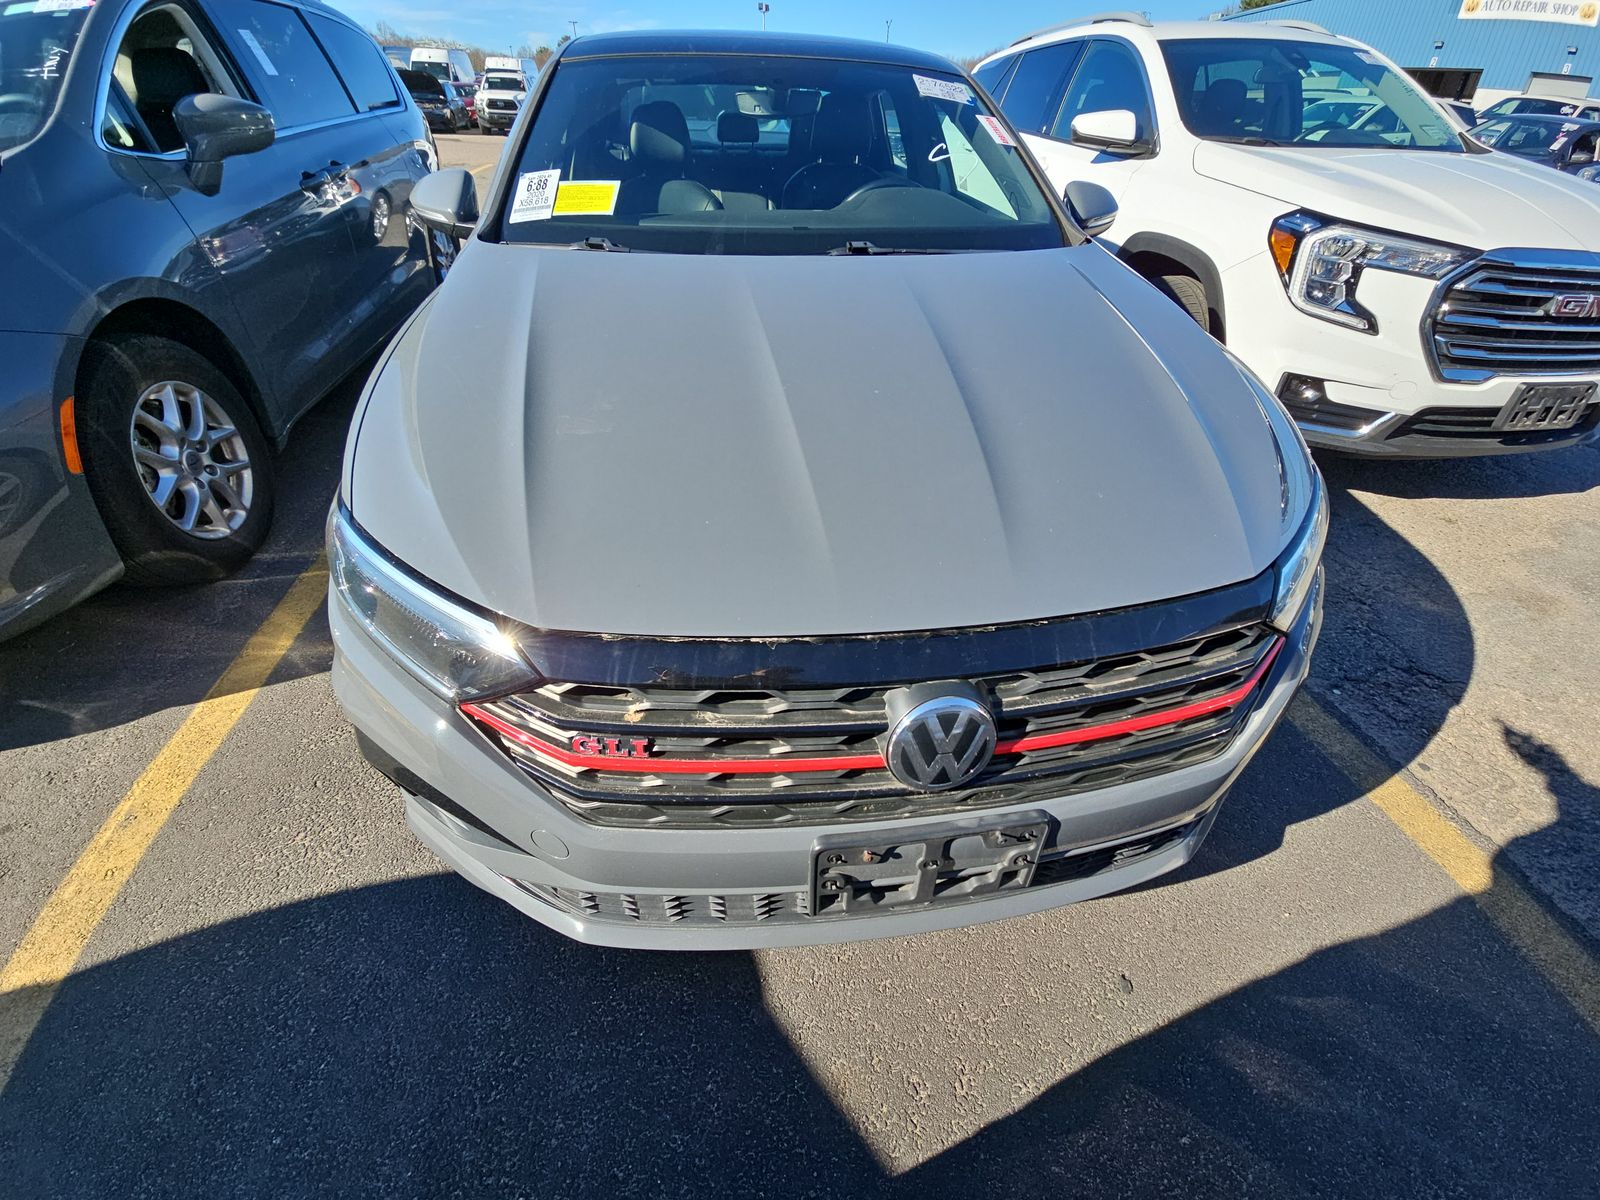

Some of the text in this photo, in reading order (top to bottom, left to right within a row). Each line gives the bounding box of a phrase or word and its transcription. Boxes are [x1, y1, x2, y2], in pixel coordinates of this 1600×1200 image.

[1481, 0, 1579, 16] AUTO REPAIR SHOP
[527, 178, 549, 192] 6:88
[572, 736, 650, 758] GLI
